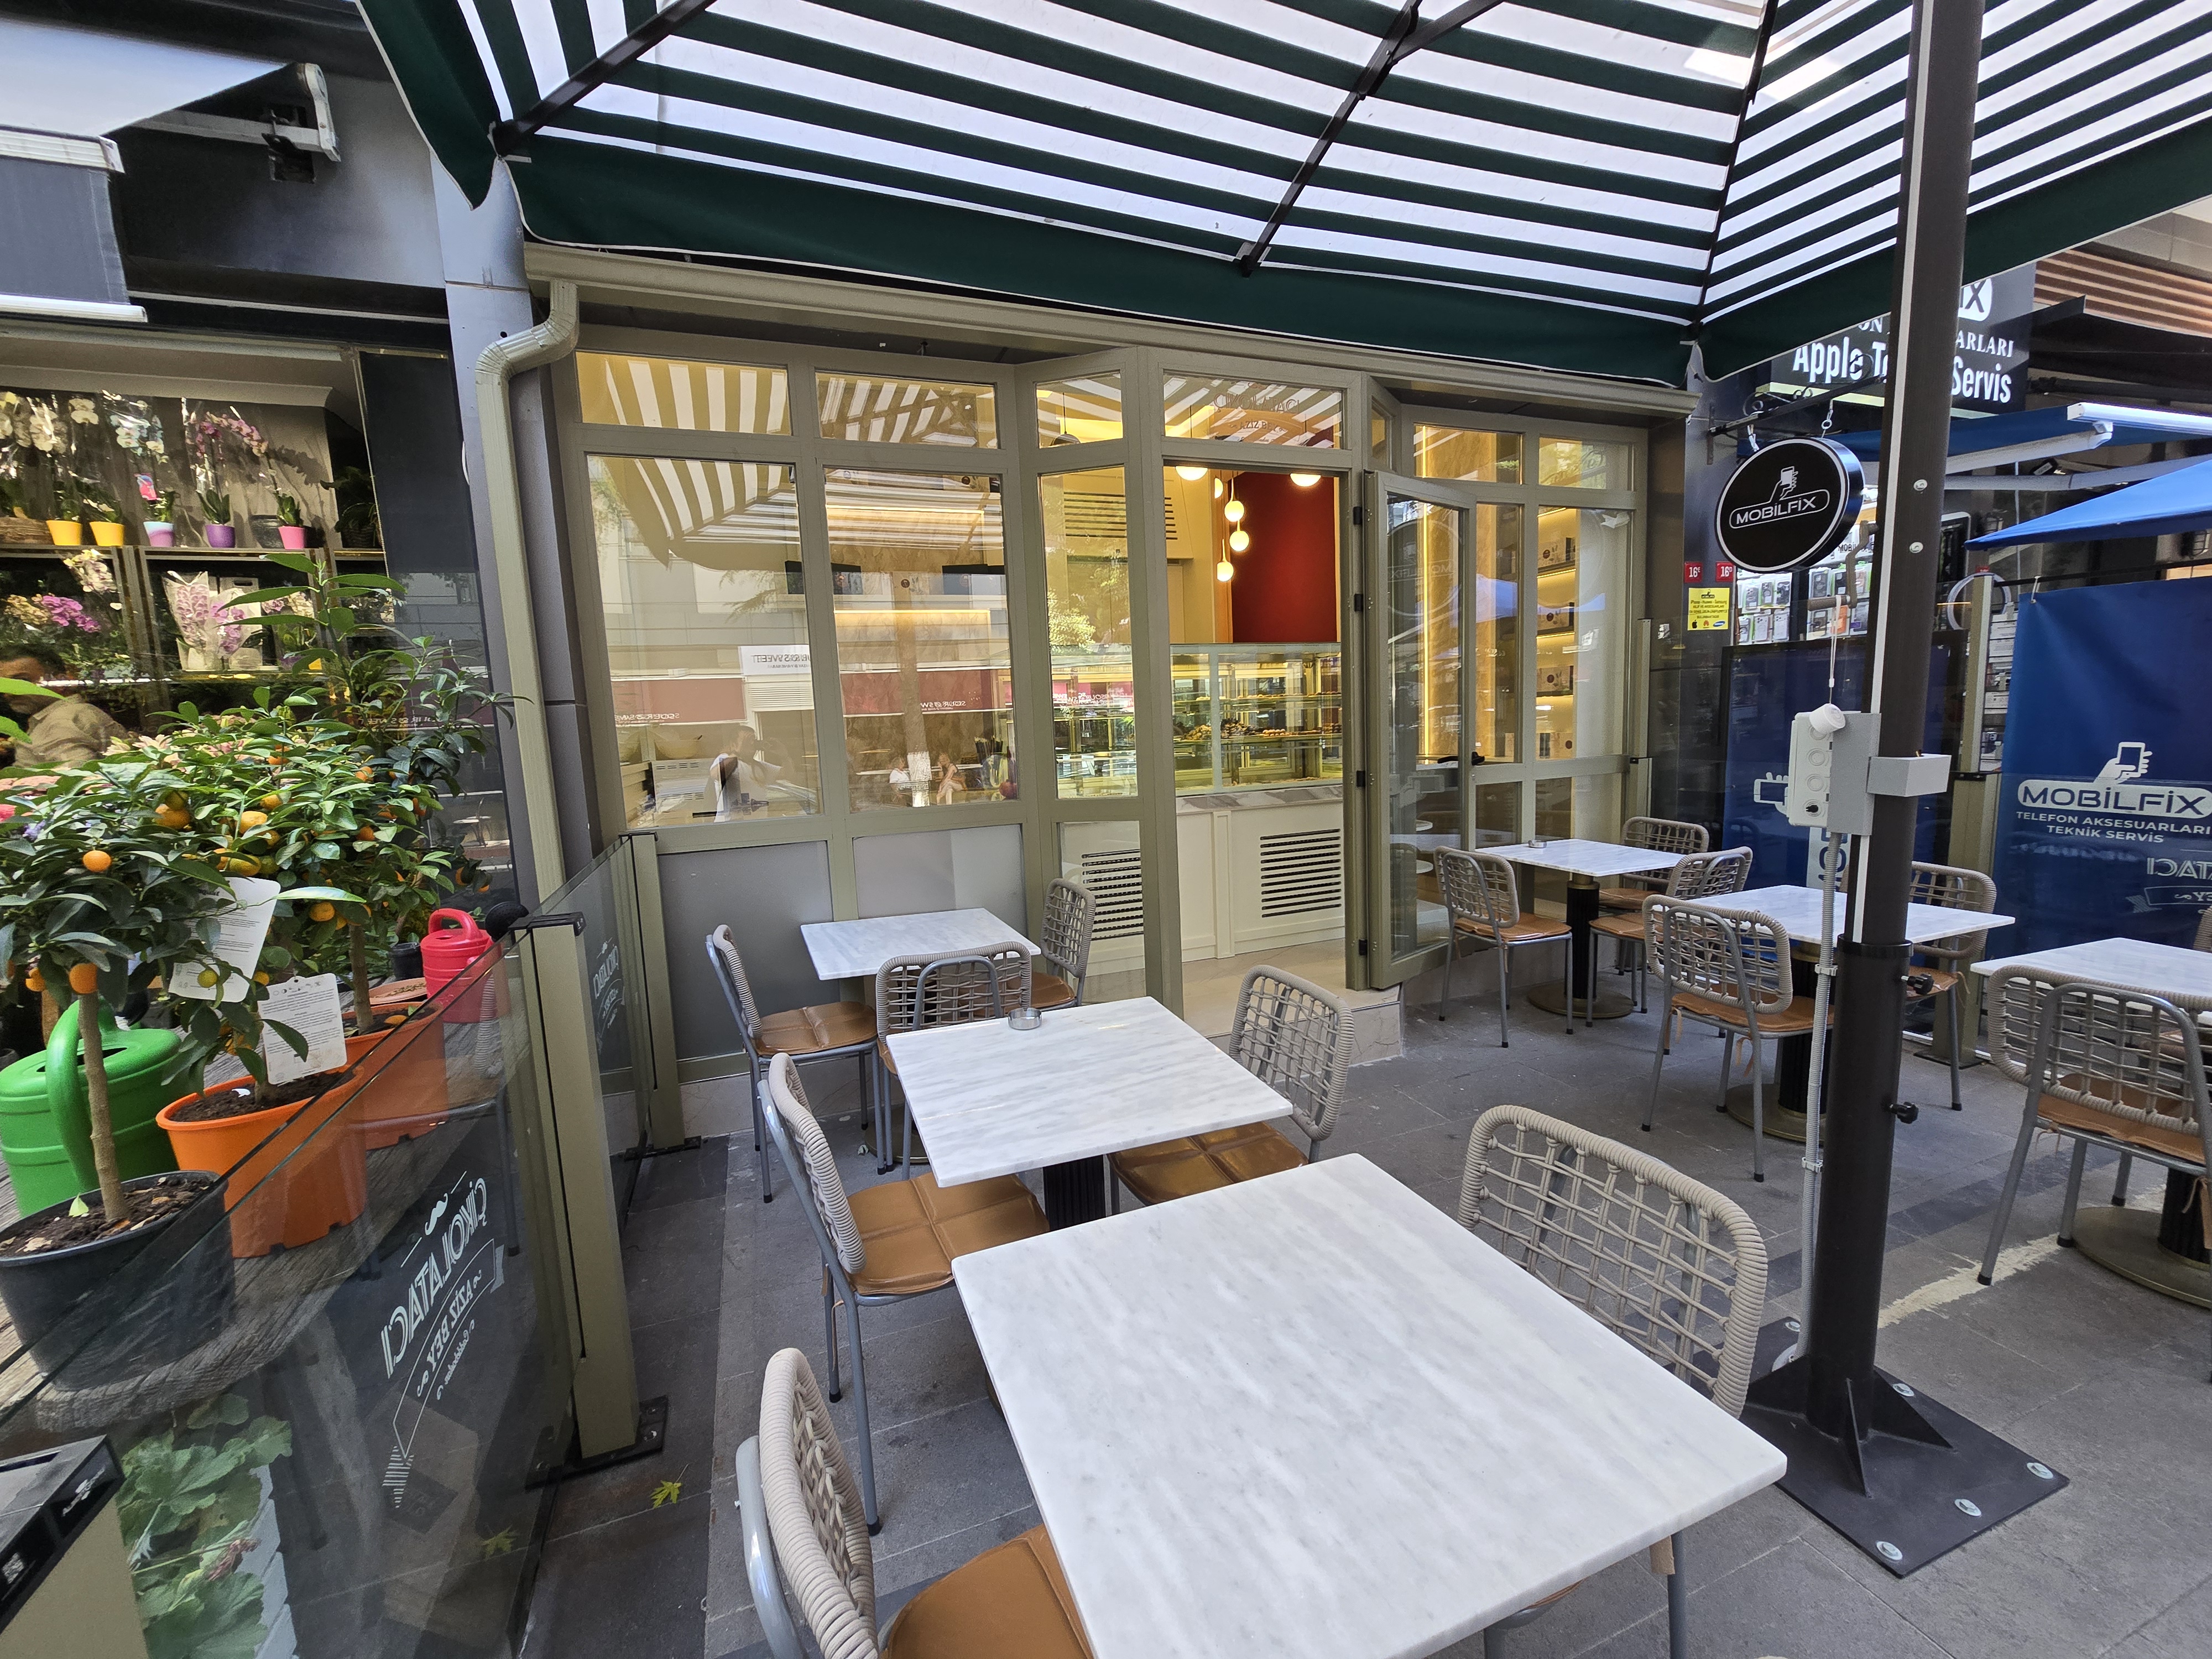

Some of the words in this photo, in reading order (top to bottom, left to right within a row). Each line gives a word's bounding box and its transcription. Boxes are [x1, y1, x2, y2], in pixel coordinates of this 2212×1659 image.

[1792, 336, 1864, 384] Apple
[1952, 356, 2012, 404] Servis
[1239, 419, 1260, 430] AZİZ
[1736, 496, 1817, 524] MOBİLFİX
[2022, 785, 2207, 816] MOBİLFİX
[2016, 811, 2078, 825] TELEFON
[2081, 817, 2211, 835] AKSESUARLARI
[2047, 825, 2102, 838] TEKNİK
[2105, 829, 2164, 843] SERVİS
